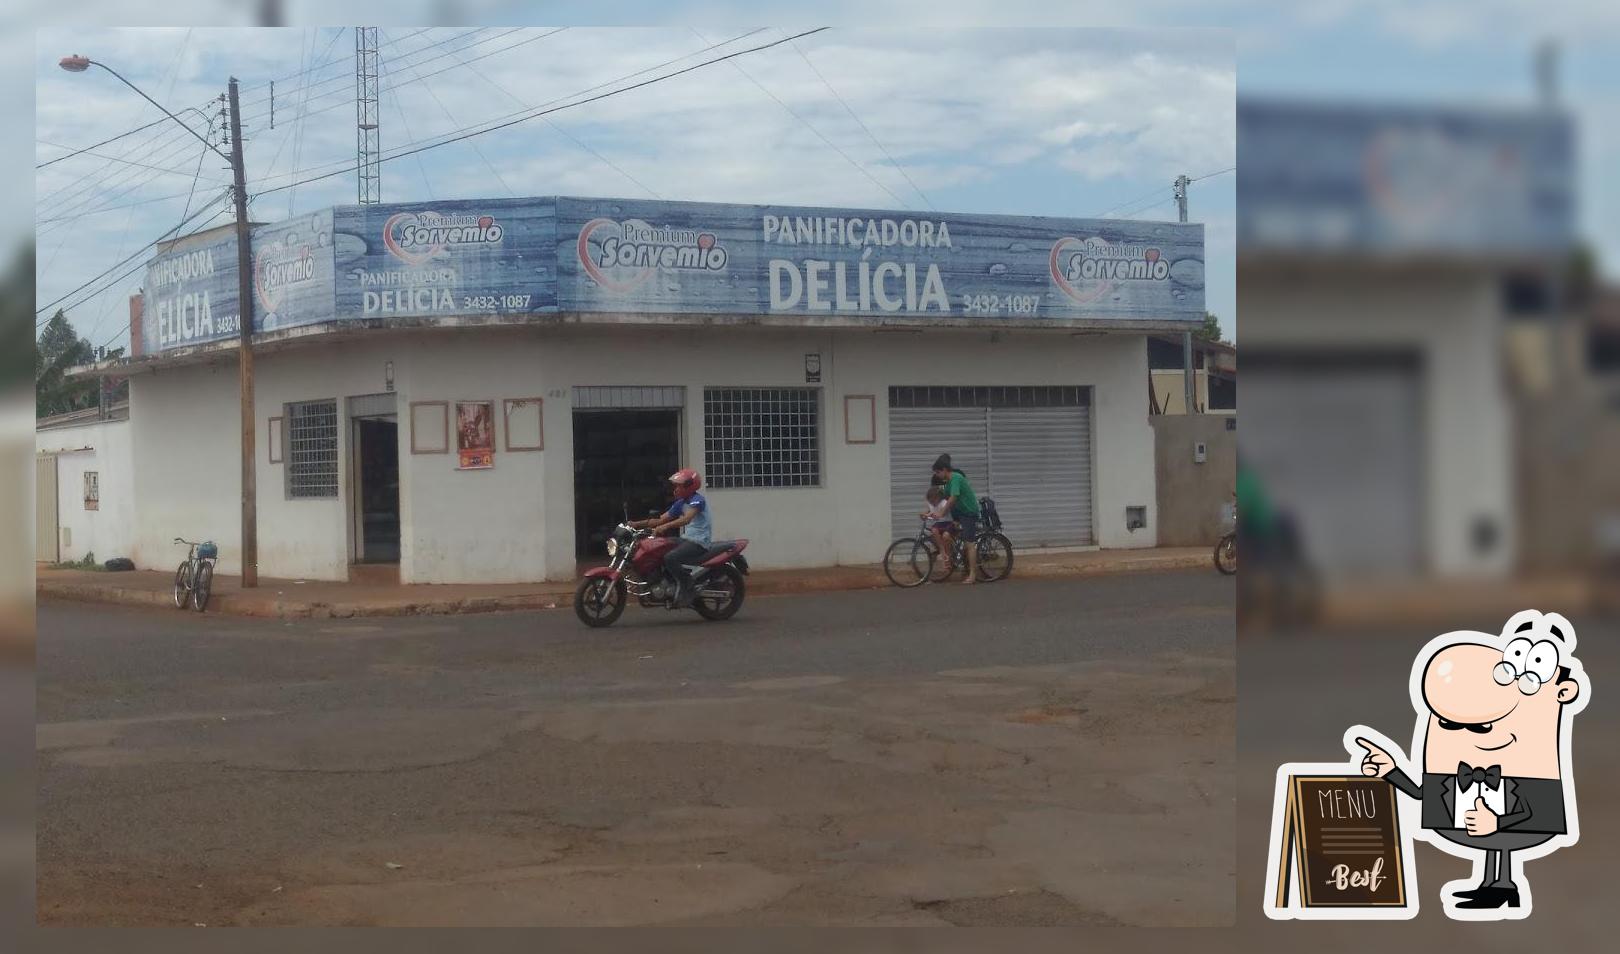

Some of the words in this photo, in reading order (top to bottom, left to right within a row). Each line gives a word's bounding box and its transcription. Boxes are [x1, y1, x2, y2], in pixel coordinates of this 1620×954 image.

[401, 219, 503, 248] Sorvemio
[419, 212, 478, 227] Premium
[624, 224, 695, 243] Premium
[763, 215, 952, 248] PANIFICADORA
[600, 234, 727, 270] Sorvemio
[1087, 241, 1145, 256] Premium
[360, 271, 457, 287] PANIFICADORA
[1067, 250, 1170, 281] Sorvemio
[768, 248, 951, 312] DELÍCIA
[963, 295, 1040, 313] 3432-1087
[363, 285, 455, 313] DELÍCIA
[464, 295, 531, 309] 3432-1087
[157, 283, 214, 346] ELÍCIA
